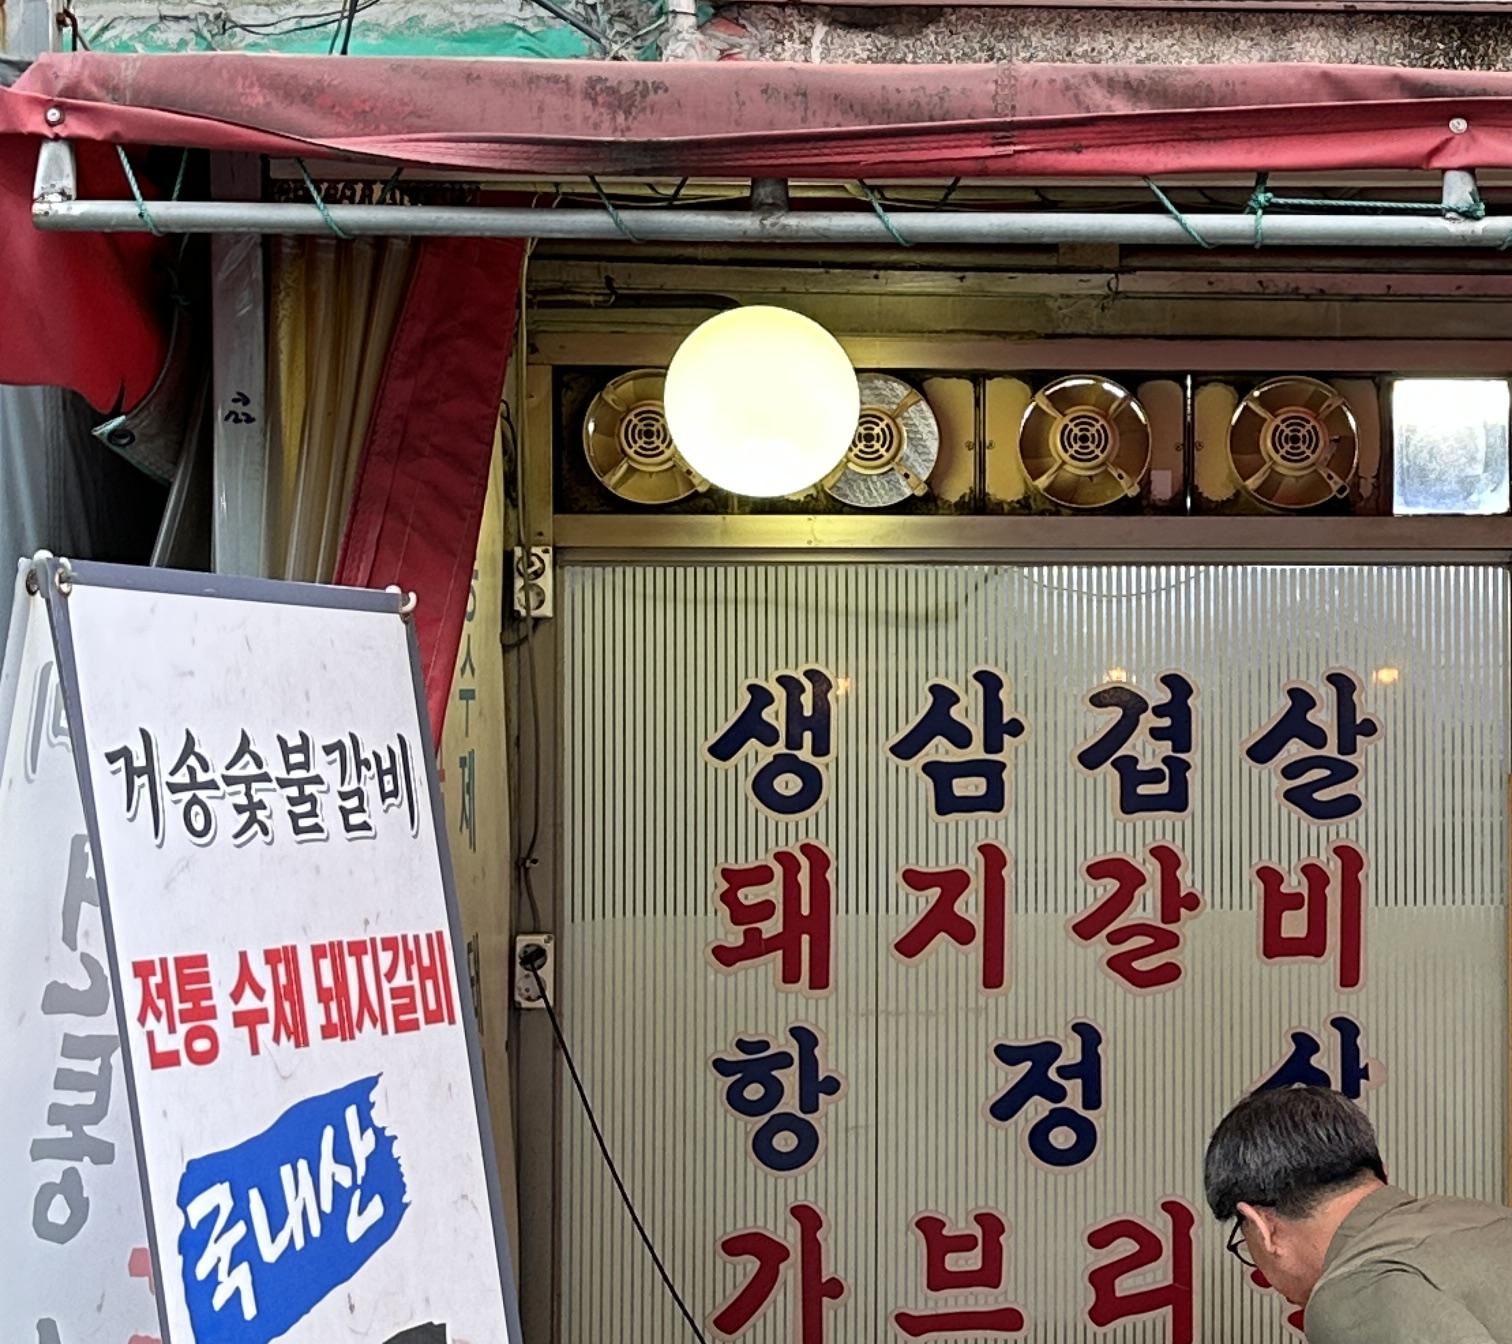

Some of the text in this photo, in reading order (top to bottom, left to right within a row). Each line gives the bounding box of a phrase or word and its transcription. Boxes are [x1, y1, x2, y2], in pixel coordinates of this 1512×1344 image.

[704, 668, 1380, 820] 생삼겹살
[710, 842, 1367, 992] 돼지갈비
[132, 953, 221, 1071] 전통
[229, 943, 310, 1057] 수제
[310, 931, 457, 1042] 돼지갈비
[187, 1104, 385, 1323] 국내산
